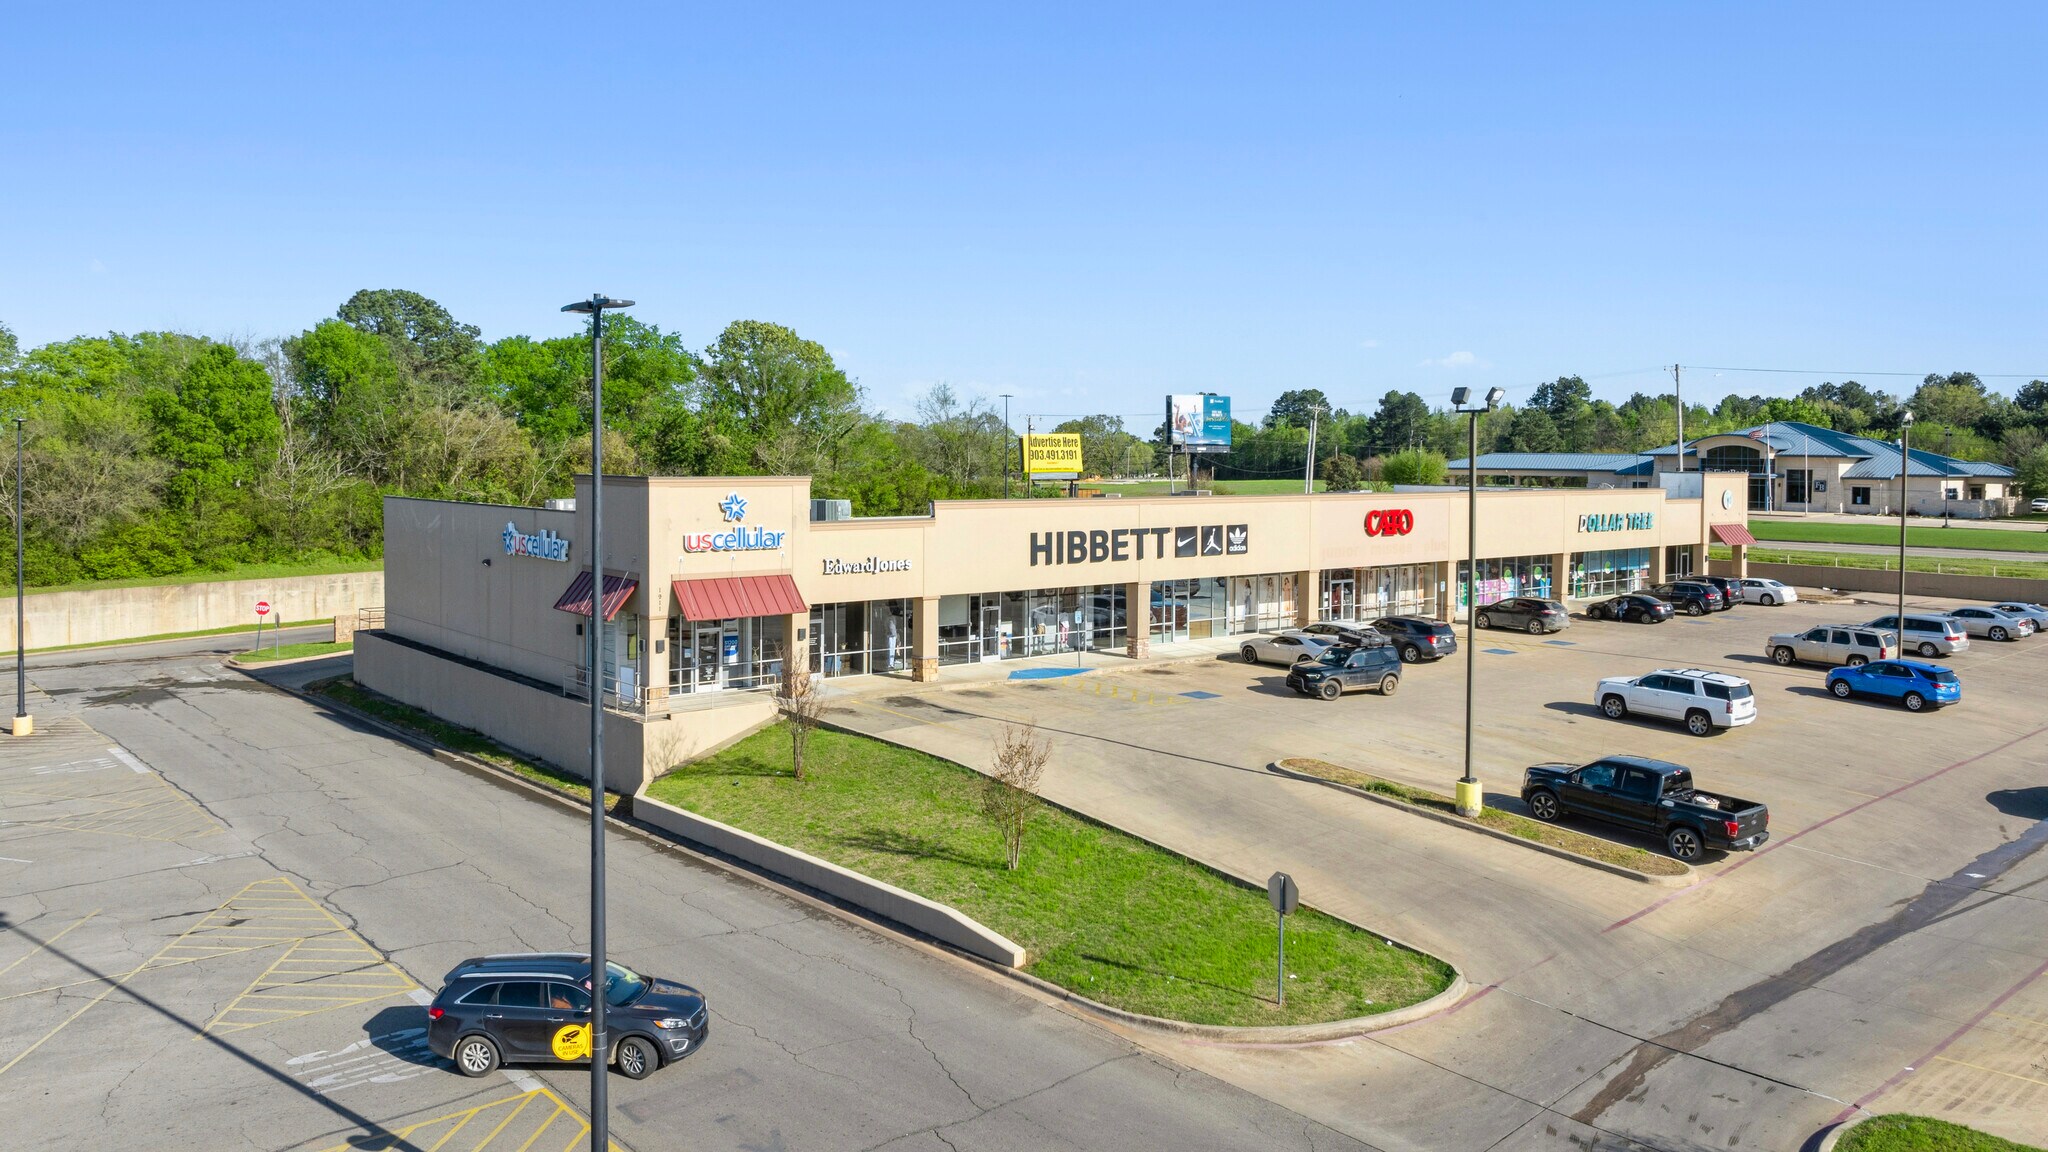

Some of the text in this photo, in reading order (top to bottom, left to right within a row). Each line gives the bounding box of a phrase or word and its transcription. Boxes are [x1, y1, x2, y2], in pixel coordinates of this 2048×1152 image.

[1030, 449, 1078, 460] 903.491.3191
[1063, 436, 1079, 448] Here
[1364, 508, 1414, 537] CATO
[1578, 511, 1655, 533] DOLLAR TREE
[514, 530, 566, 560] uscellular
[686, 526, 786, 552] uscellular
[1030, 527, 1170, 566] HIBBETT
